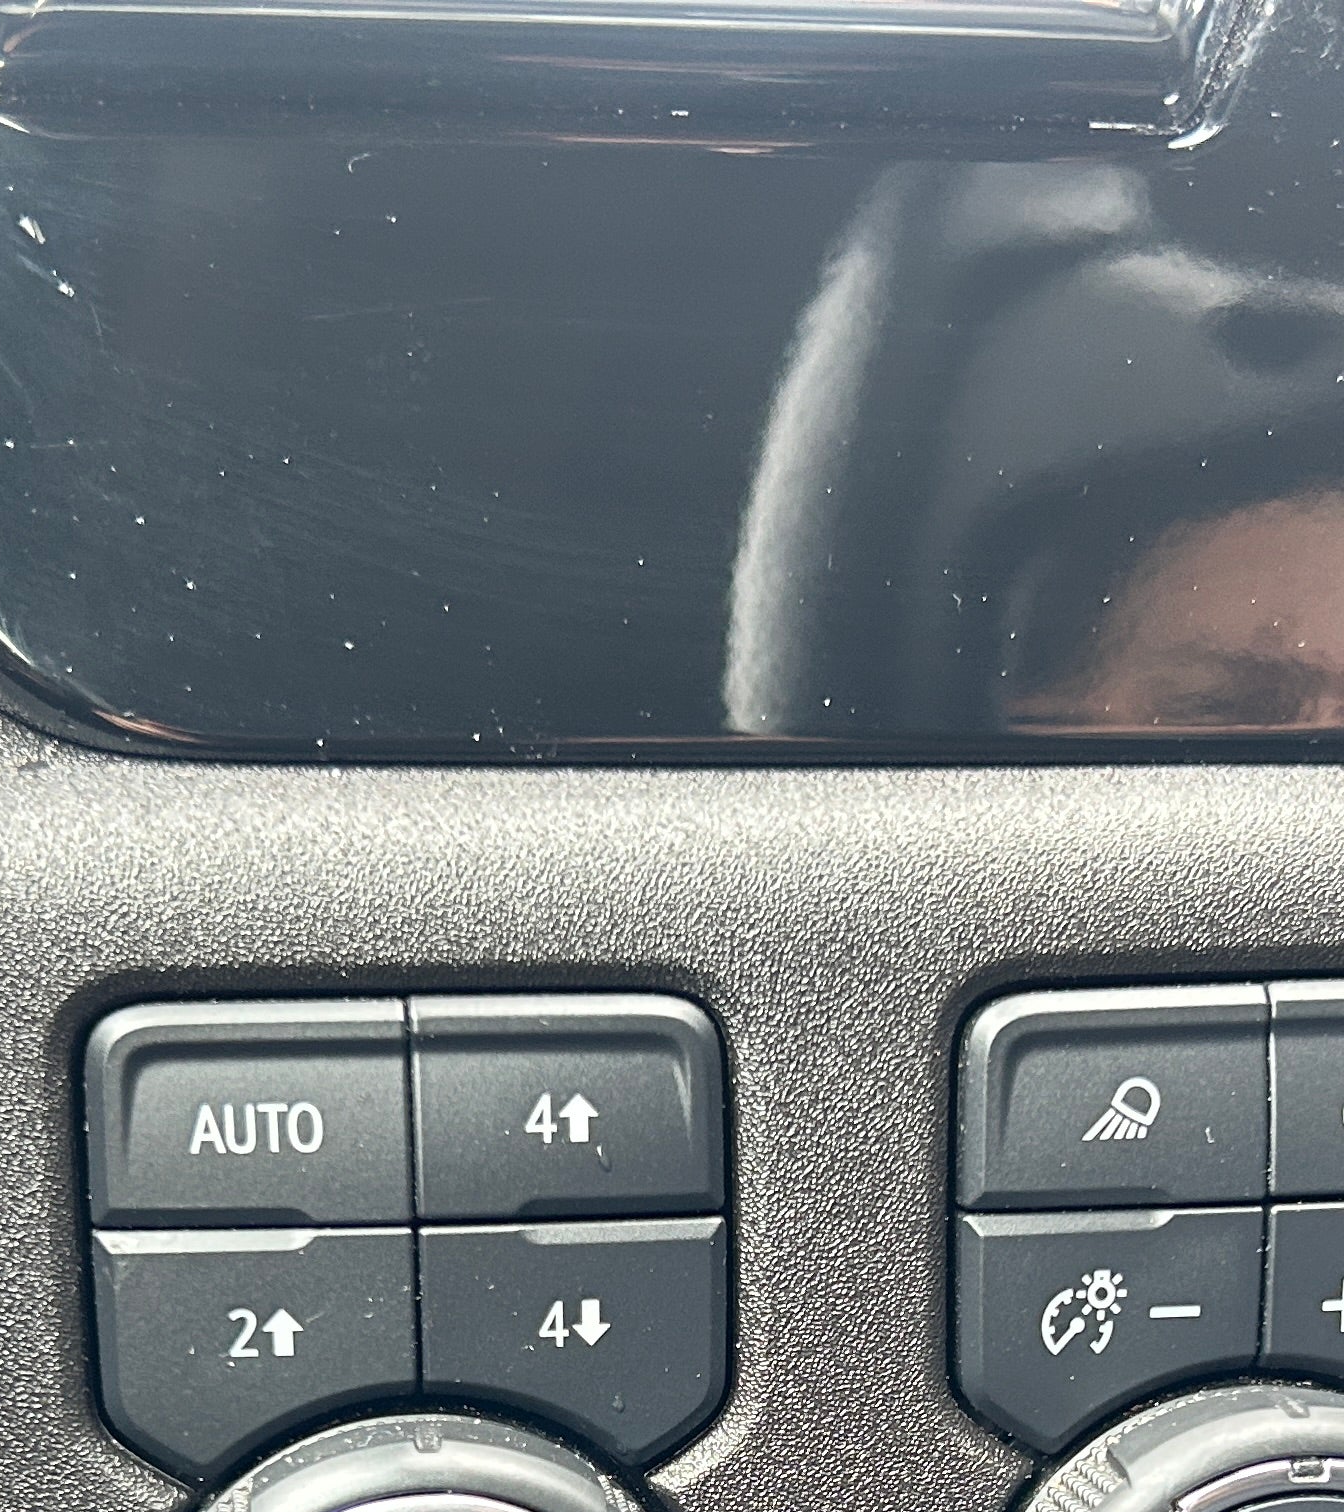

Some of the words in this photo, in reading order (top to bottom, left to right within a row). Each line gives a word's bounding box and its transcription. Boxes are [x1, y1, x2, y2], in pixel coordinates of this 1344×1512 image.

[189, 1102, 324, 1155] AUTO
[524, 1092, 557, 1145] 4
[227, 1308, 259, 1359] 2
[538, 1300, 569, 1349] 4
